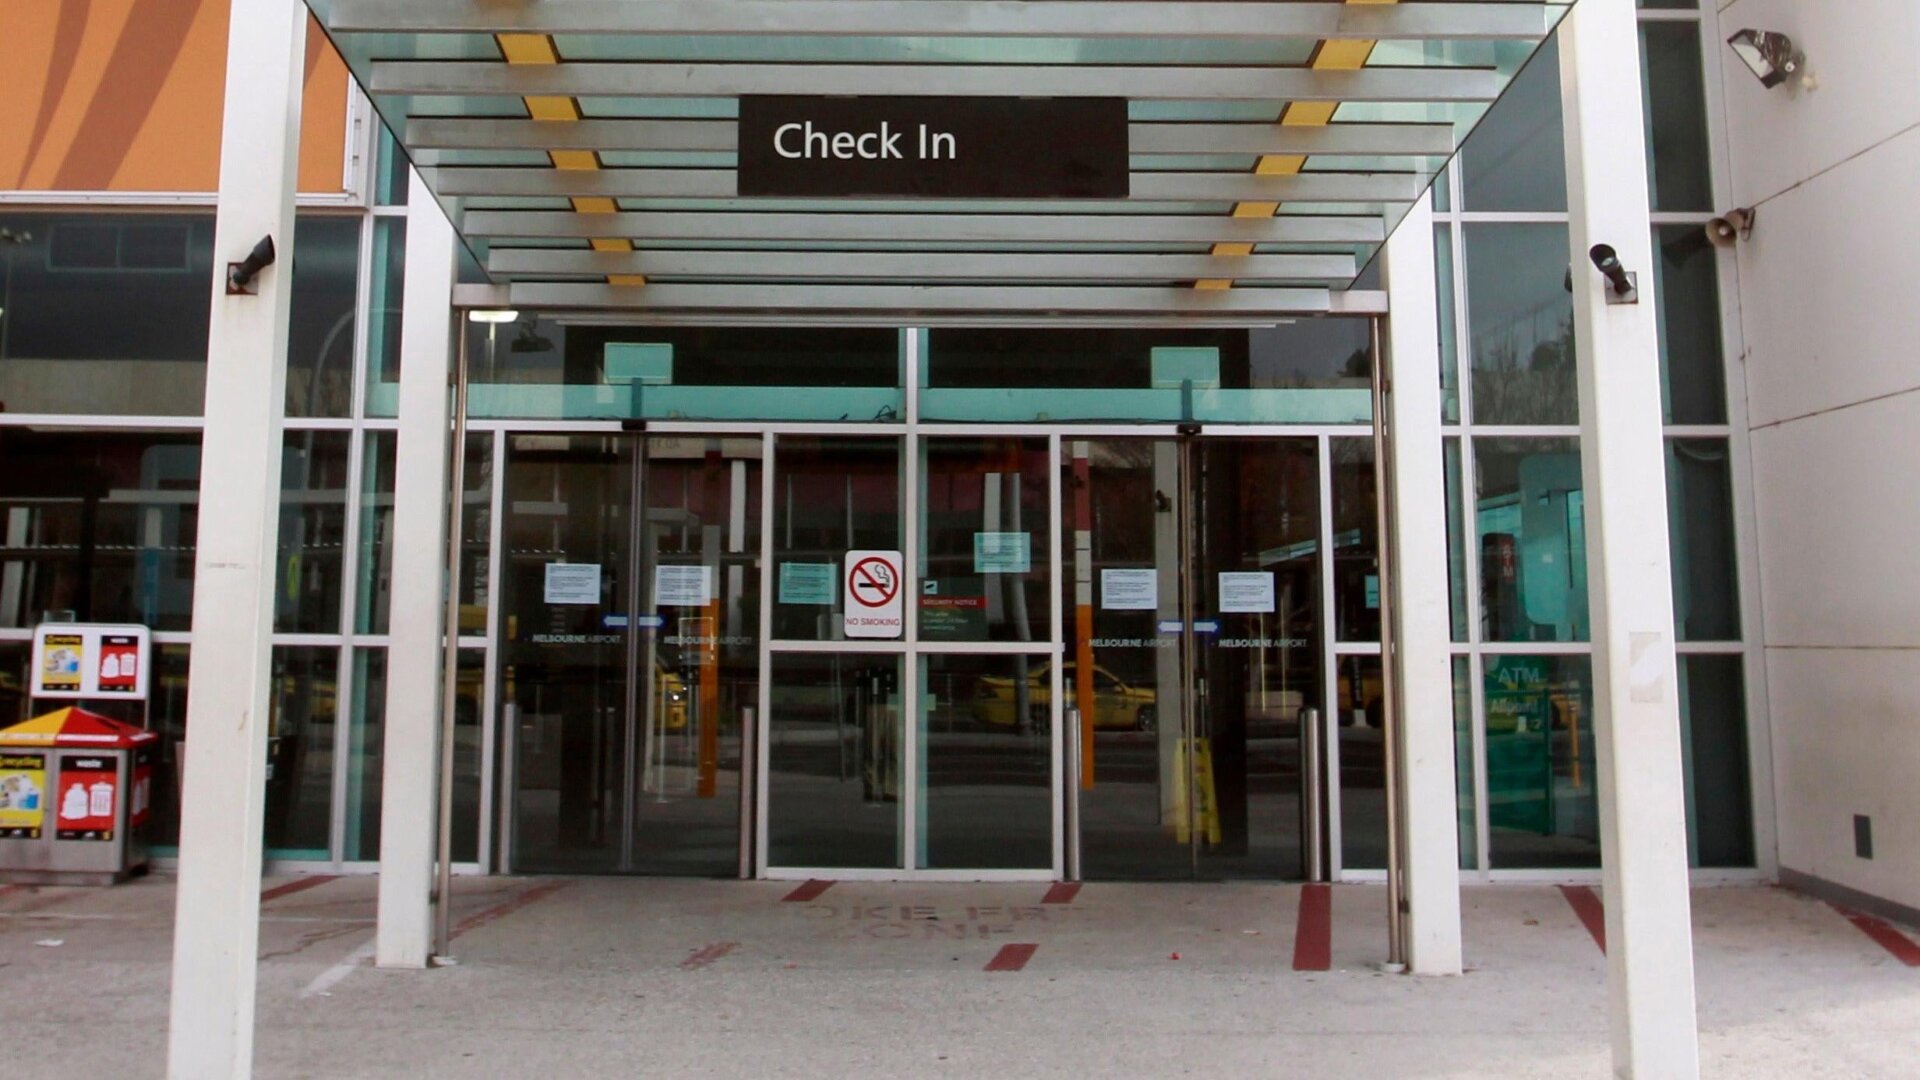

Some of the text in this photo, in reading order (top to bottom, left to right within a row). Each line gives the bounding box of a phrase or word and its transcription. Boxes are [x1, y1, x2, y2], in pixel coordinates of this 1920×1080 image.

[773, 120, 957, 160] Check In
[845, 618, 901, 627] NO SMOKING
[532, 634, 621, 644] MELBOURNE AIRPORT
[663, 635, 752, 645] MELBOURNE AIRPORT
[1088, 638, 1177, 648] MELBOURNE AIRPORT
[1218, 638, 1307, 648] MELBOURNE AIRPORT
[1498, 667, 1540, 683] ATM
